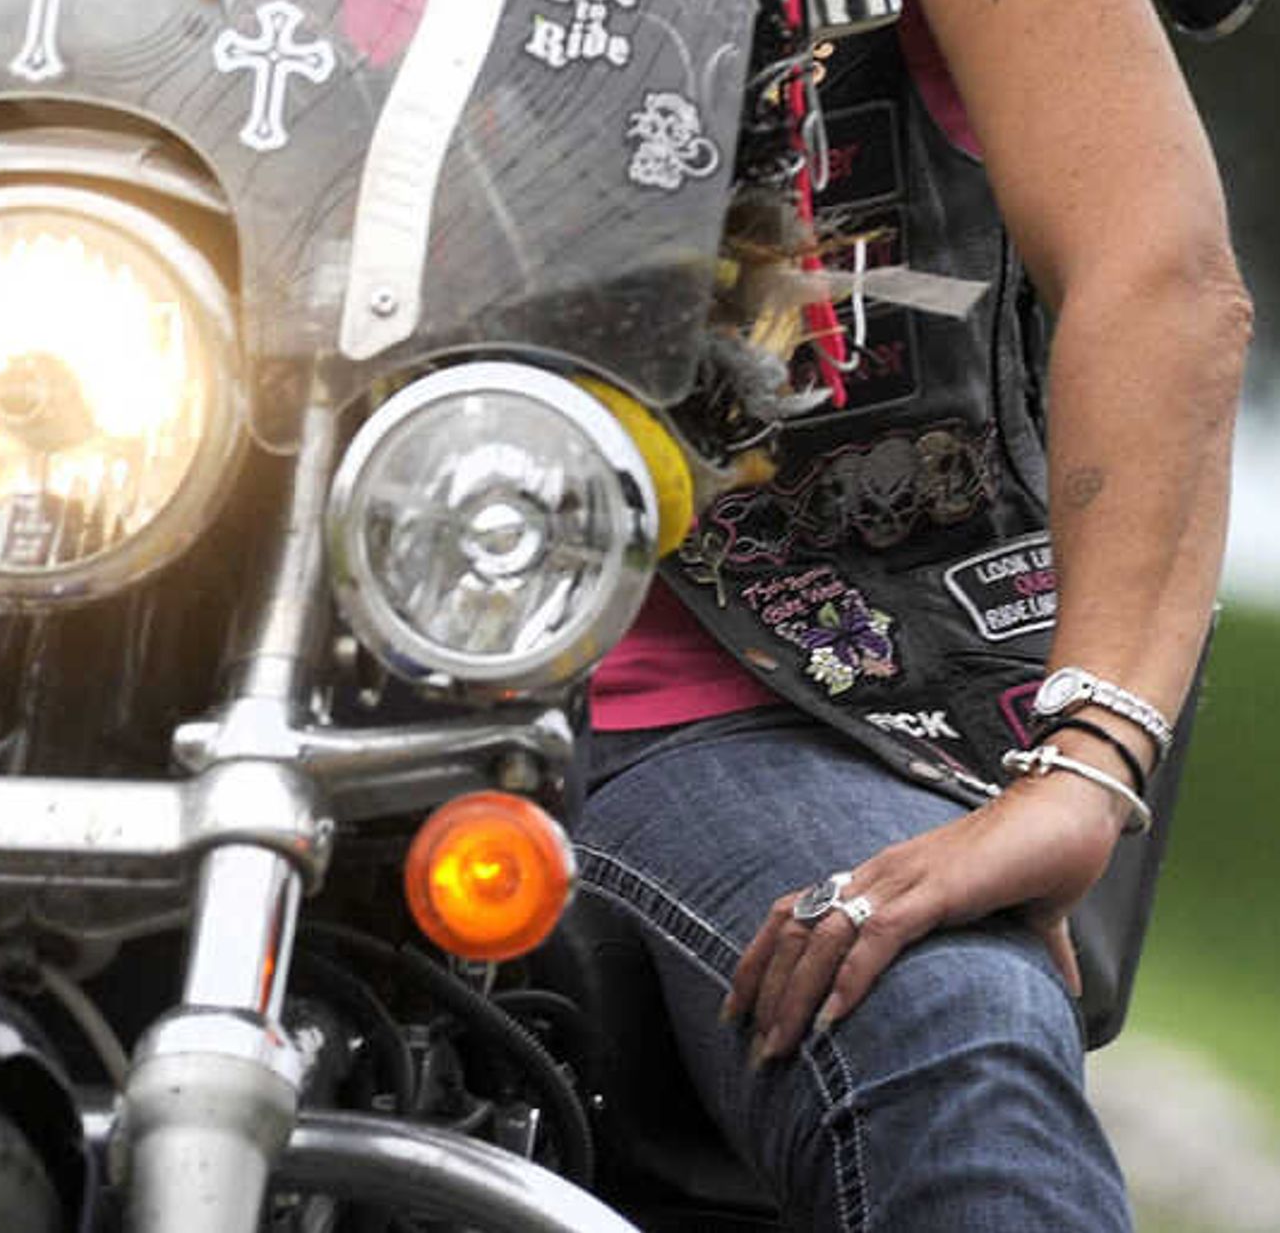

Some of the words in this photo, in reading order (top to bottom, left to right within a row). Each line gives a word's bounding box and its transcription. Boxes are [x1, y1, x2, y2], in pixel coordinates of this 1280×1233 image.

[575, 0, 607, 21] to
[526, 16, 630, 66] Ride
[976, 553, 1031, 584] LOOK
